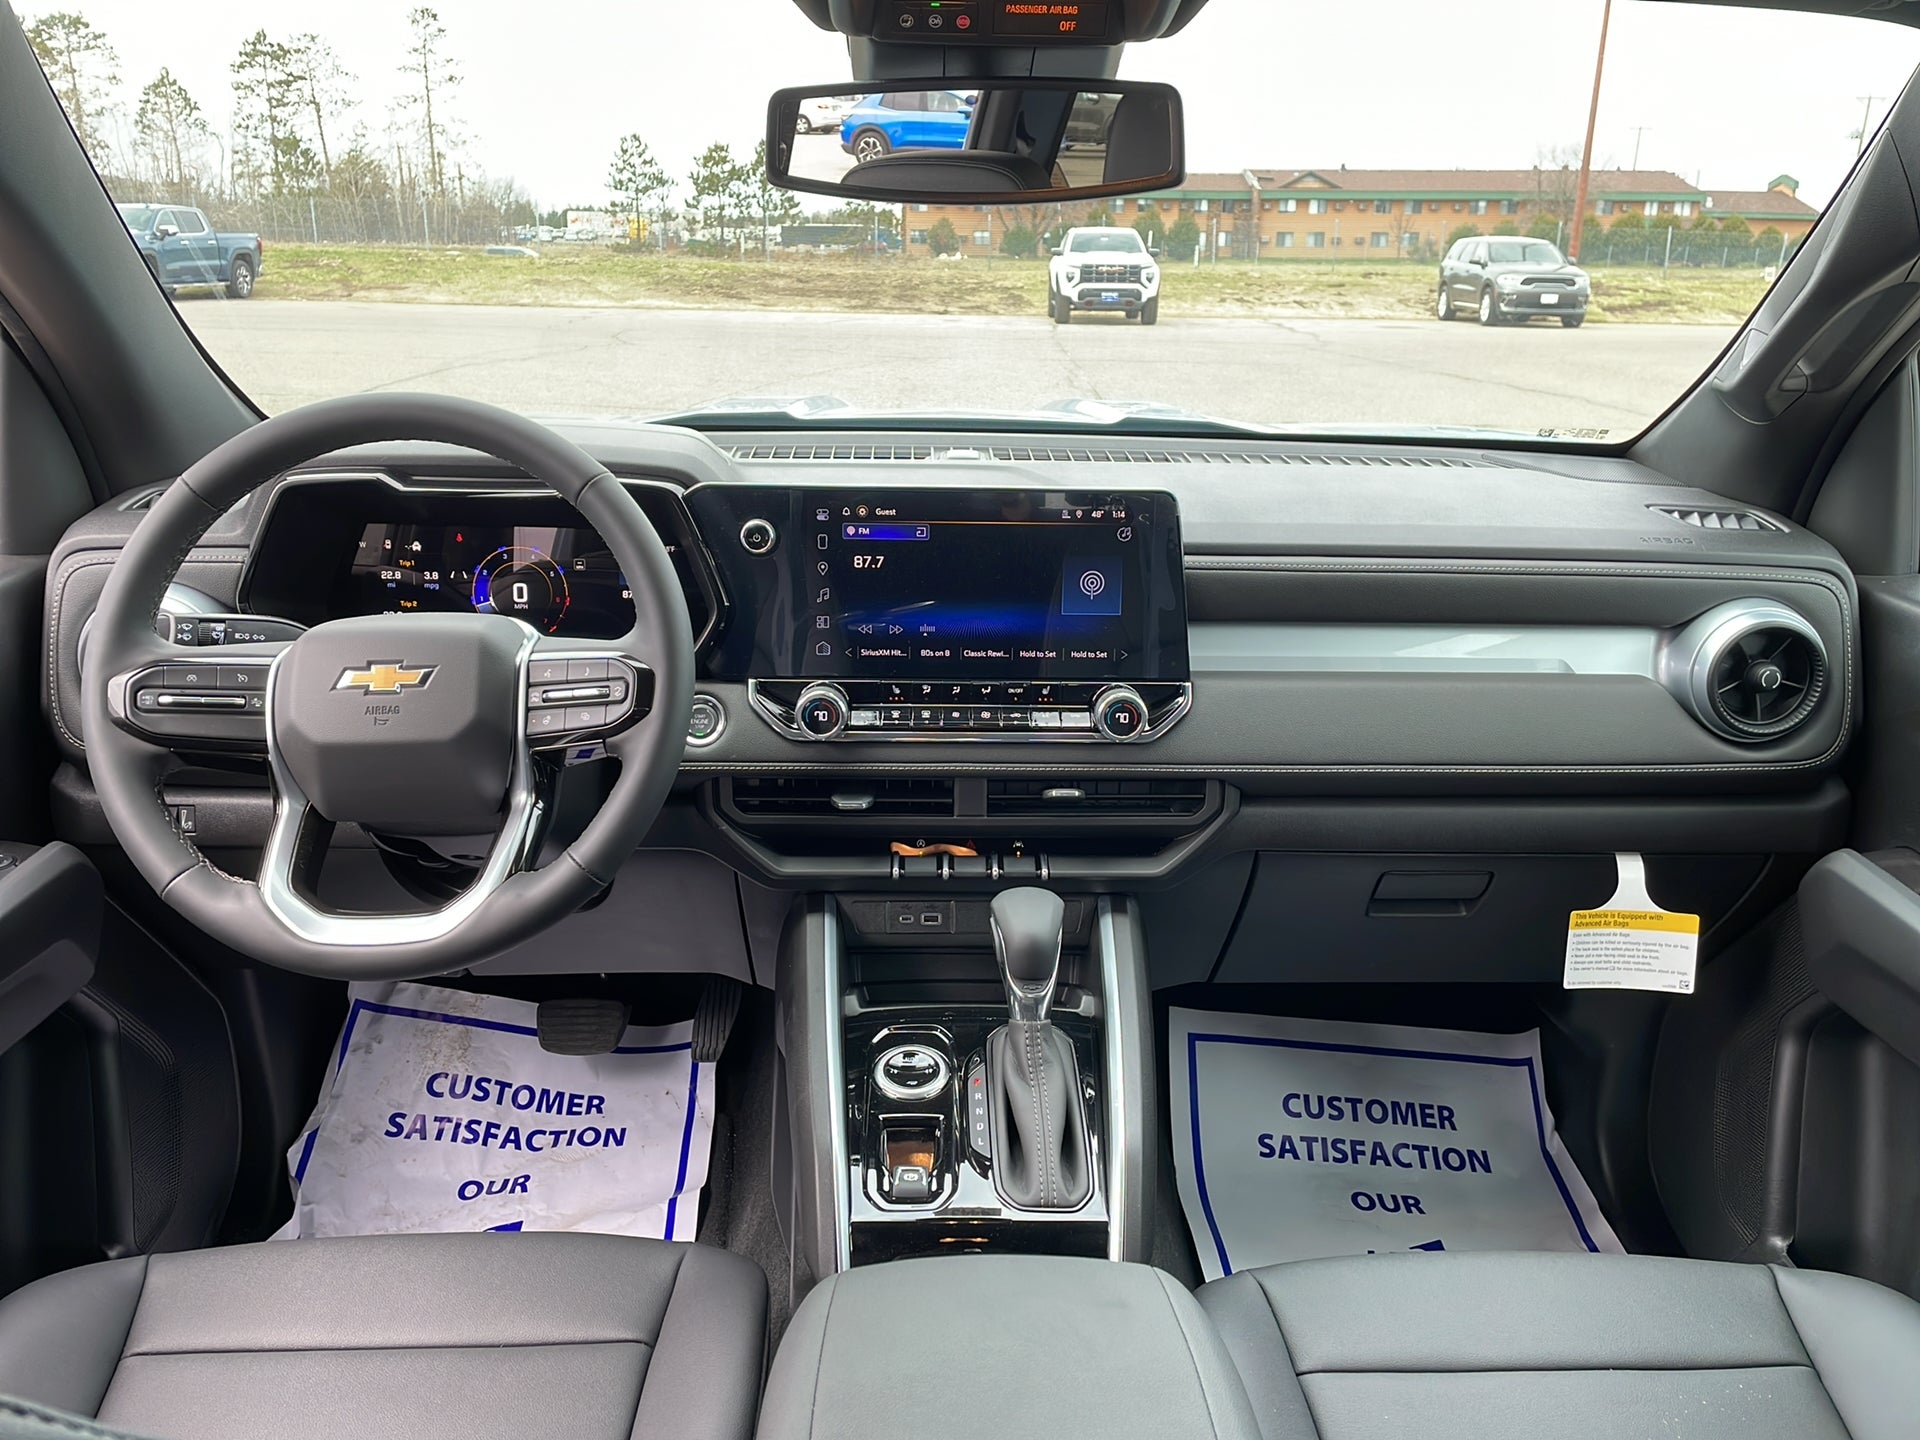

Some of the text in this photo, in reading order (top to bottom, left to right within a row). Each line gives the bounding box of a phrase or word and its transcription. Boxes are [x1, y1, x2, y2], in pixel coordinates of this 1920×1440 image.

[1006, 4, 1078, 14] PASSENGER AIR BAG
[1060, 20, 1076, 31] OFF
[876, 508, 896, 516] Guest
[1112, 510, 1126, 518] 1:14
[1640, 537, 1694, 545] AIRBAG
[400, 560, 411, 568] Trip
[854, 555, 884, 568] 87.7
[381, 570, 401, 580] 22.8
[424, 571, 438, 580] 3.8
[424, 582, 440, 590] mpg
[512, 582, 528, 602] 0
[400, 600, 412, 608] Trip
[860, 648, 908, 656] SiriusXM Hit...
[920, 649, 934, 657] 80s
[944, 649, 950, 657] 8
[964, 650, 986, 658] Classic
[1070, 650, 1087, 658] Hold
[364, 706, 400, 716] AIRBAG
[814, 710, 828, 722] 70
[1115, 712, 1130, 724] 70
[1617, 912, 1647, 922] Equipped
[1613, 920, 1630, 928] Bags
[425, 1072, 606, 1116] CUSTOMER
[974, 1092, 982, 1100] R
[976, 1107, 984, 1116] N
[1282, 1092, 1458, 1132] CUSTOMER
[976, 1122, 984, 1131] D
[384, 1112, 626, 1152] SATISFACTION
[978, 1138, 984, 1146] L
[1257, 1133, 1492, 1174] SATISFACTION
[457, 1174, 530, 1200] OUR
[1350, 1191, 1426, 1215] OUR
